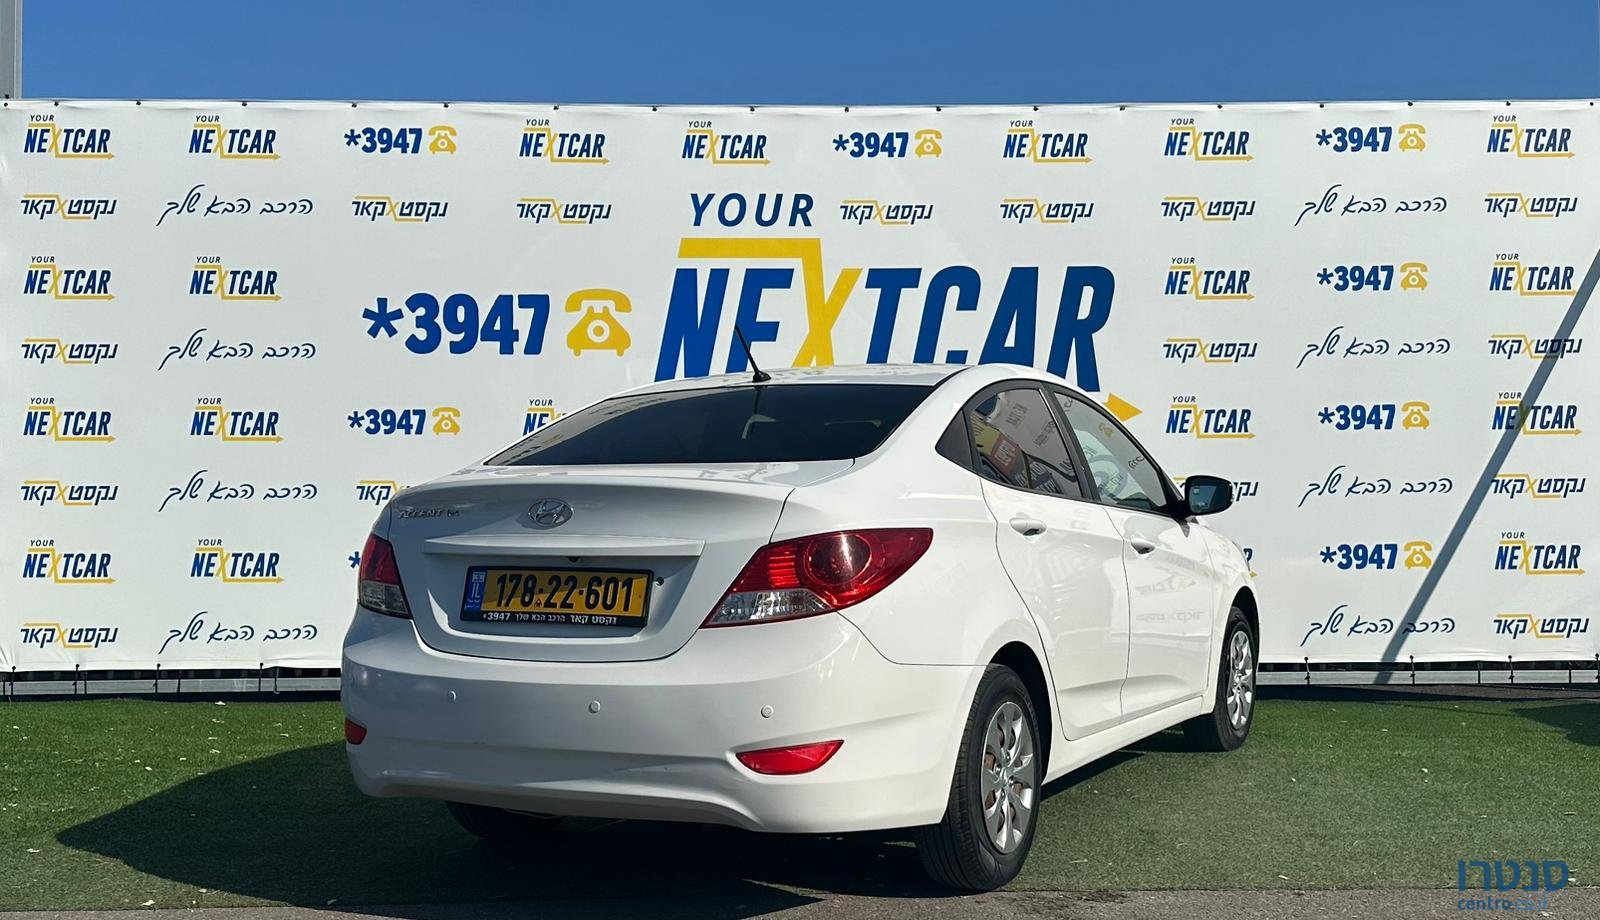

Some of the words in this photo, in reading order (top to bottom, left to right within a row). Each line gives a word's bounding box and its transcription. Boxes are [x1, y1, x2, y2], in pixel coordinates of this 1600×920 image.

[30, 114, 55, 122] YOUR
[195, 114, 220, 123] YOUR
[526, 118, 550, 127] YOUR
[688, 120, 712, 129] YOUR
[1010, 119, 1034, 128] YOUR
[1171, 117, 1195, 126] YOUR
[1493, 114, 1517, 123] YOUR
[23, 129, 111, 154] NEXTCAR
[188, 129, 277, 154] NEXTCAR
[519, 133, 606, 158] NEXTCAR
[681, 135, 767, 160] NEXTCAR
[1002, 133, 1089, 159] NEXTCAR
[1163, 131, 1250, 157] NEXTCAR
[1486, 128, 1572, 153] NEXTCAR
[156, 184, 205, 226] שלך
[204, 195, 251, 216] הבא
[259, 198, 313, 214] הרכב
[691, 193, 813, 227] YOUR
[1294, 184, 1342, 226] שלך
[1341, 195, 1386, 216] הבא
[1395, 197, 1447, 213] הרכב
[31, 255, 55, 264] YOUR
[196, 255, 221, 264] YOUR
[1171, 256, 1196, 265] YOUR
[1495, 253, 1519, 261] YOUR
[23, 270, 112, 295] NEXTCAR
[189, 270, 278, 296] NEXTCAR
[1164, 270, 1251, 296] NEXTCAR
[1488, 267, 1575, 292] NEXTCAR
[158, 328, 207, 371] שלך
[206, 340, 253, 361] הבא
[262, 343, 316, 359] הרכב
[1296, 326, 1344, 368] שלך
[1343, 337, 1389, 358] הבא
[1398, 339, 1450, 355] הרכב
[30, 397, 55, 405] YOUR
[197, 397, 222, 405] YOUR
[1172, 395, 1197, 403] YOUR
[1498, 391, 1522, 400] YOUR
[22, 411, 112, 437] NEXTCAR
[189, 411, 280, 437] NEXTCAR
[1165, 409, 1252, 434] NEXTCAR
[1491, 405, 1578, 431] NEXTCAR
[158, 470, 208, 512] שלך
[207, 481, 254, 502] הבא
[263, 484, 317, 500] הרכב
[1298, 465, 1346, 507] שלך
[1345, 476, 1391, 497] הבא
[1400, 478, 1453, 494] הרכב
[30, 539, 55, 547] YOUR
[197, 538, 223, 547] YOUR
[1501, 531, 1525, 540] YOUR
[22, 553, 112, 579] NEXTCAR
[190, 553, 280, 578] NEXTCAR
[1494, 545, 1582, 571] NEXTCAR
[158, 611, 208, 654] שלך
[207, 622, 254, 644] הבא
[263, 625, 317, 641] הרכב
[1300, 605, 1348, 647] שלך
[1347, 615, 1393, 637] הבא
[1402, 618, 1455, 634] הרכב
